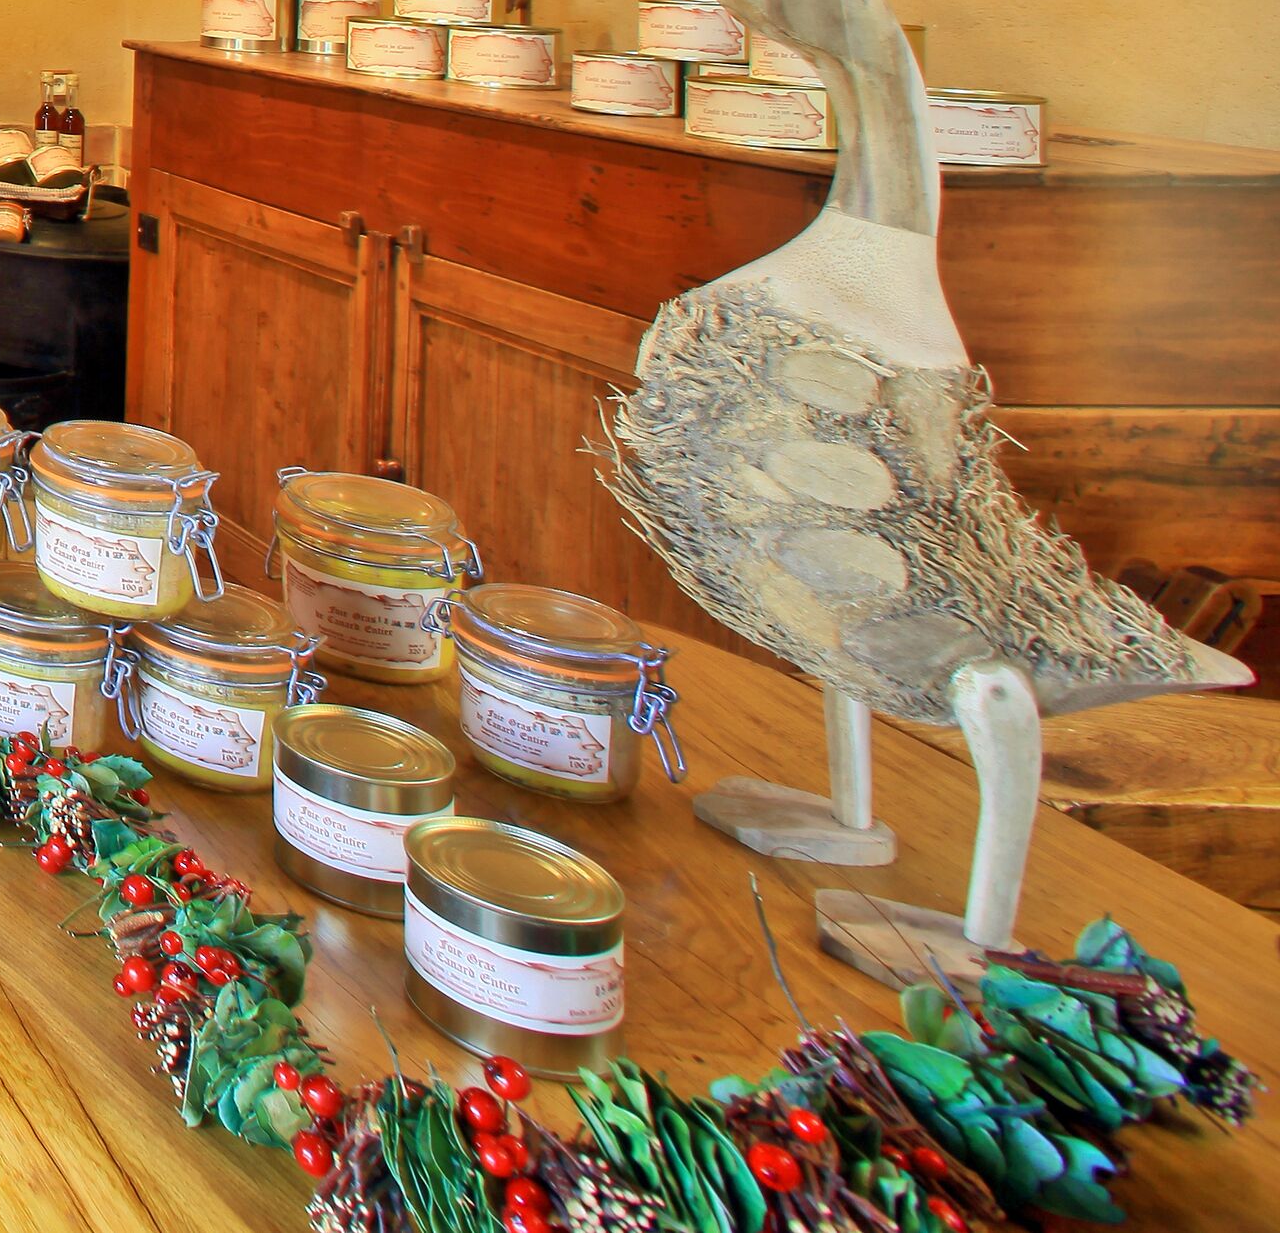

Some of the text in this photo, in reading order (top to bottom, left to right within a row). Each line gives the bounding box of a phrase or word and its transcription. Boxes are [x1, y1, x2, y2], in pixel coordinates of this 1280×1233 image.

[54, 538, 69, 549] Foie
[53, 548, 77, 562] Canard
[80, 558, 105, 571] Entier
[151, 702, 166, 715] Foie
[487, 709, 504, 722] Foie
[150, 710, 176, 729] Canard
[179, 726, 205, 740] Entier
[486, 718, 516, 736] Canard
[519, 731, 549, 747] Entier
[299, 806, 347, 832] Foie Gras
[298, 816, 330, 838] Canard
[333, 832, 367, 850] Entier
[423, 940, 520, 995] de Canard Entier
[438, 939, 496, 973] Foie Gras
